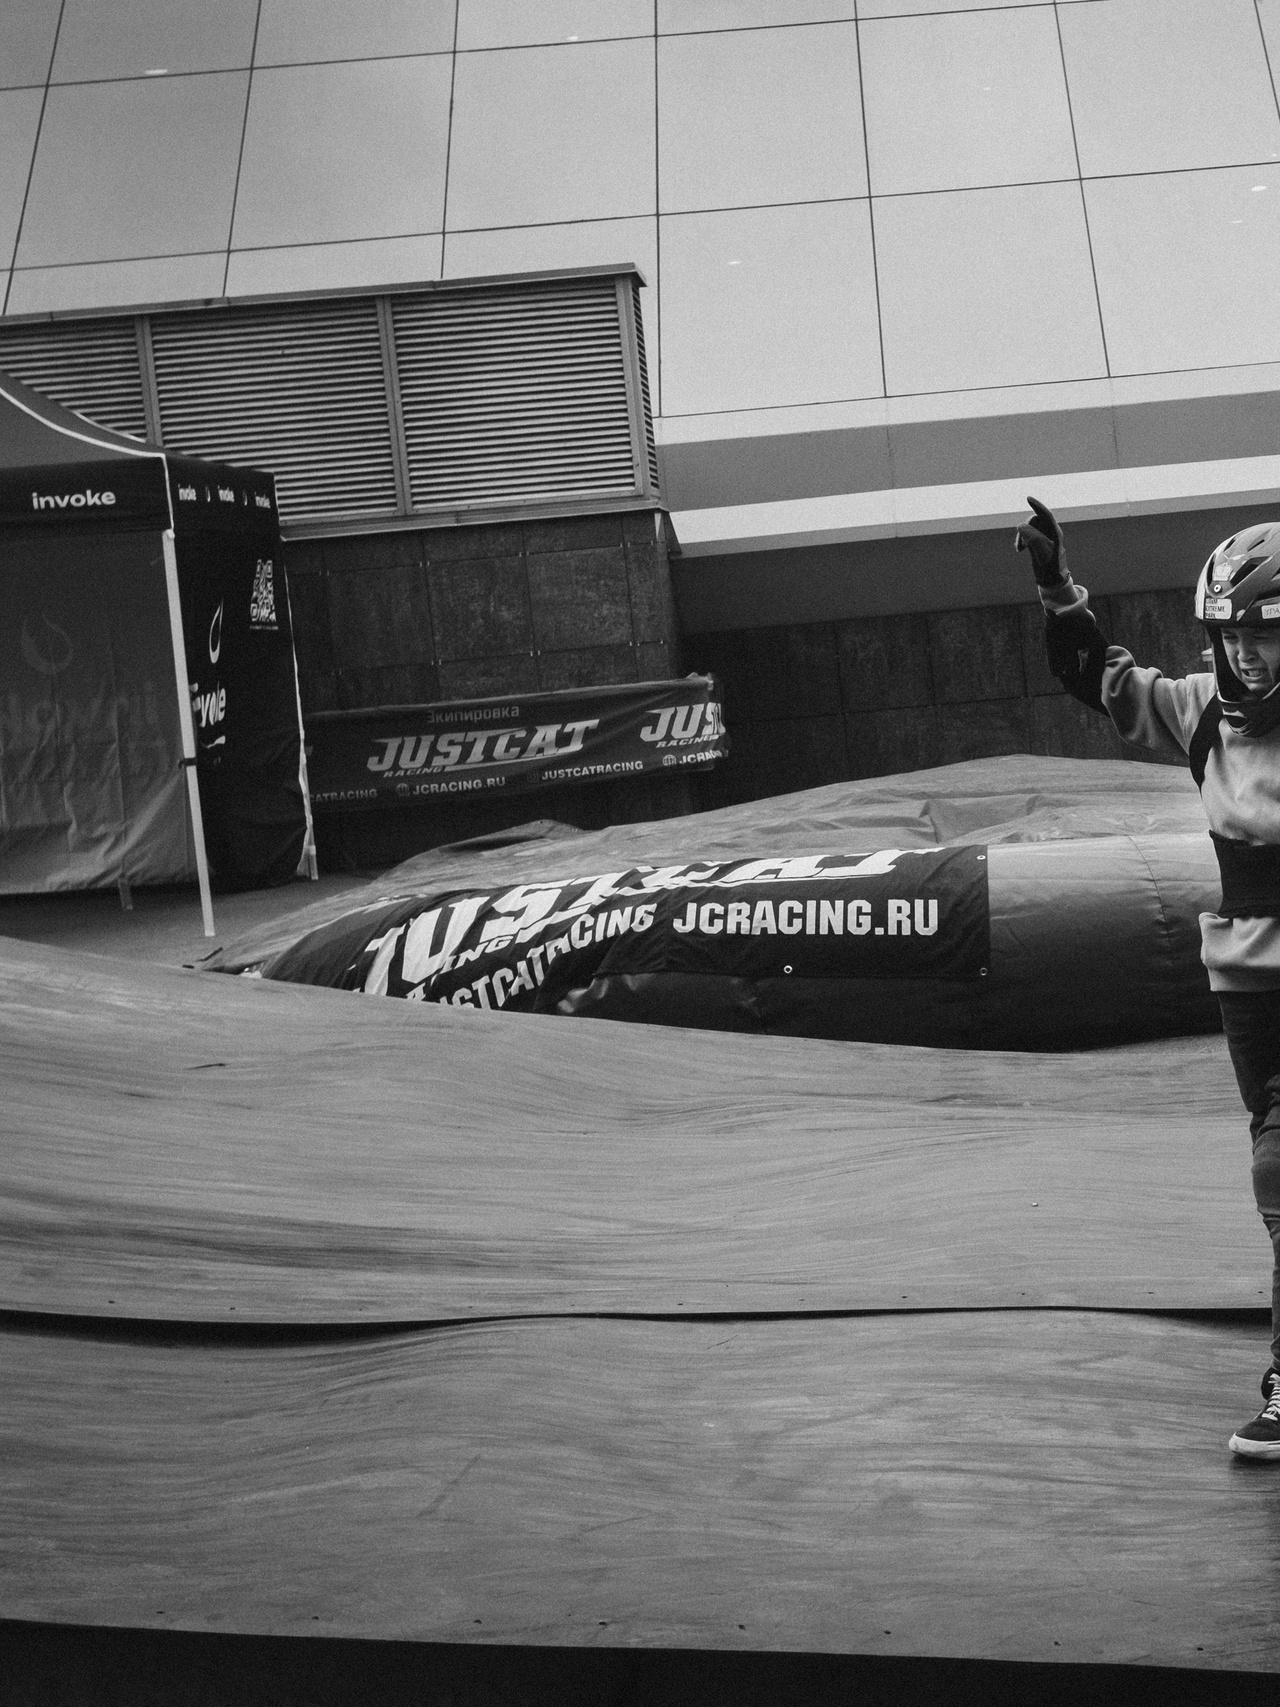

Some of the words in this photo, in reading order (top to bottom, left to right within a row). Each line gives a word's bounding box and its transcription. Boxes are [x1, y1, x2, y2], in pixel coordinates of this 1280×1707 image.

[32, 489, 116, 510] invoke
[427, 706, 519, 724] Экипировка
[367, 719, 600, 771] JUSTCAT
[383, 766, 442, 778] RACING
[541, 760, 644, 781] JUSTCATRACING
[413, 776, 506, 796] JCRACING.RU
[673, 899, 939, 936] JCRACING.RU
